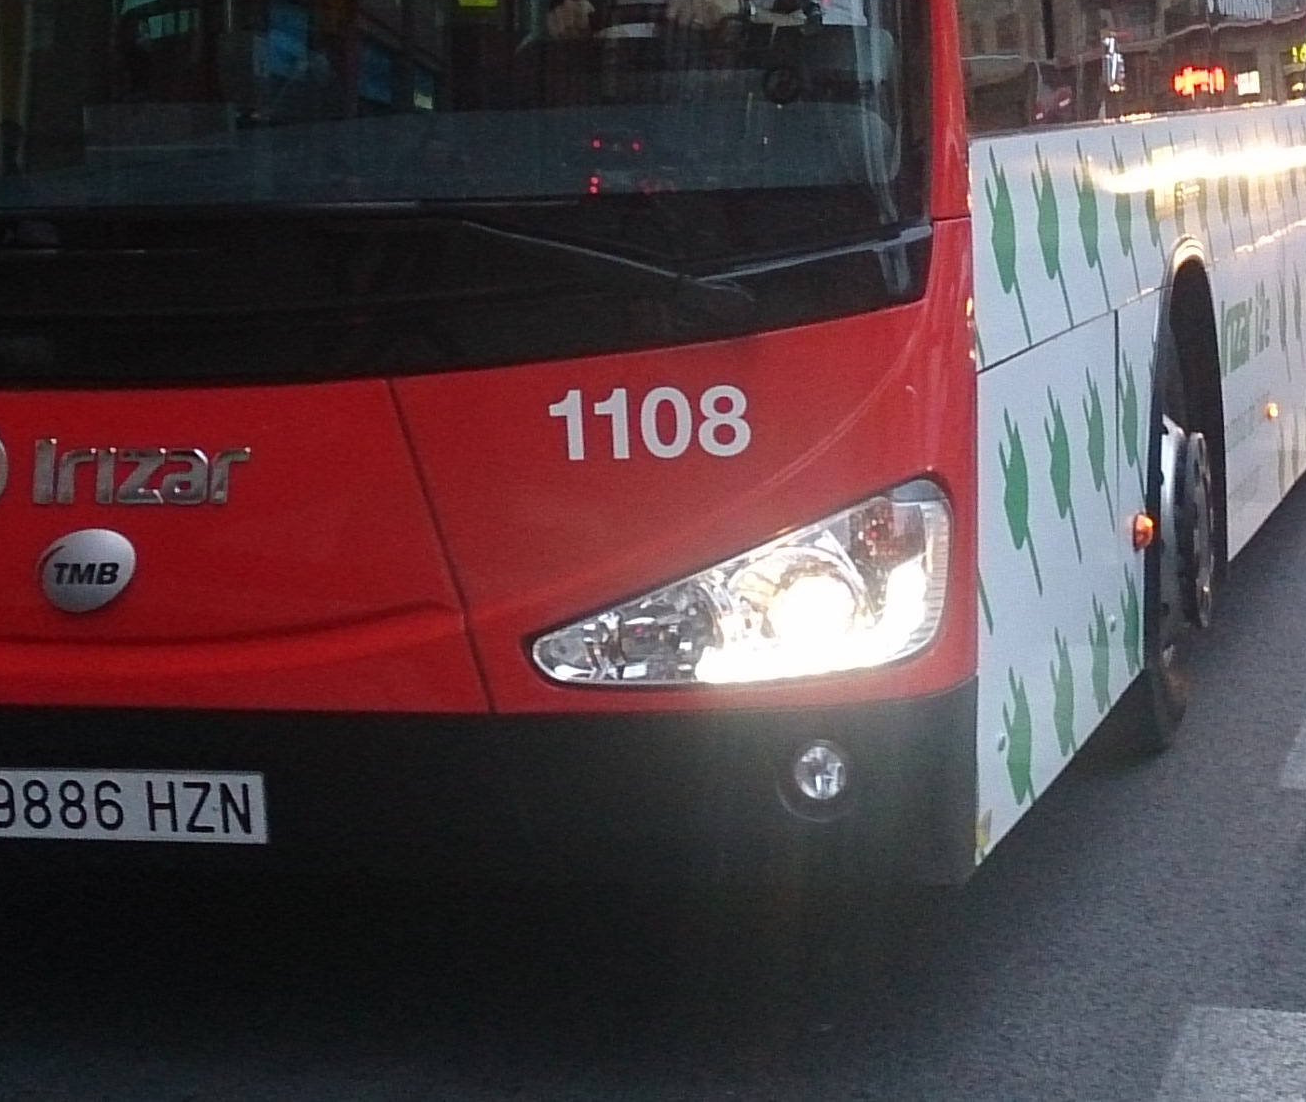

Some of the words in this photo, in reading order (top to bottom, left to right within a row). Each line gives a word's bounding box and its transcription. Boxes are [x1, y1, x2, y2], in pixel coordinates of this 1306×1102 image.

[548, 384, 752, 461] 1108
[53, 562, 119, 586] TMB
[145, 780, 252, 834] HZN
